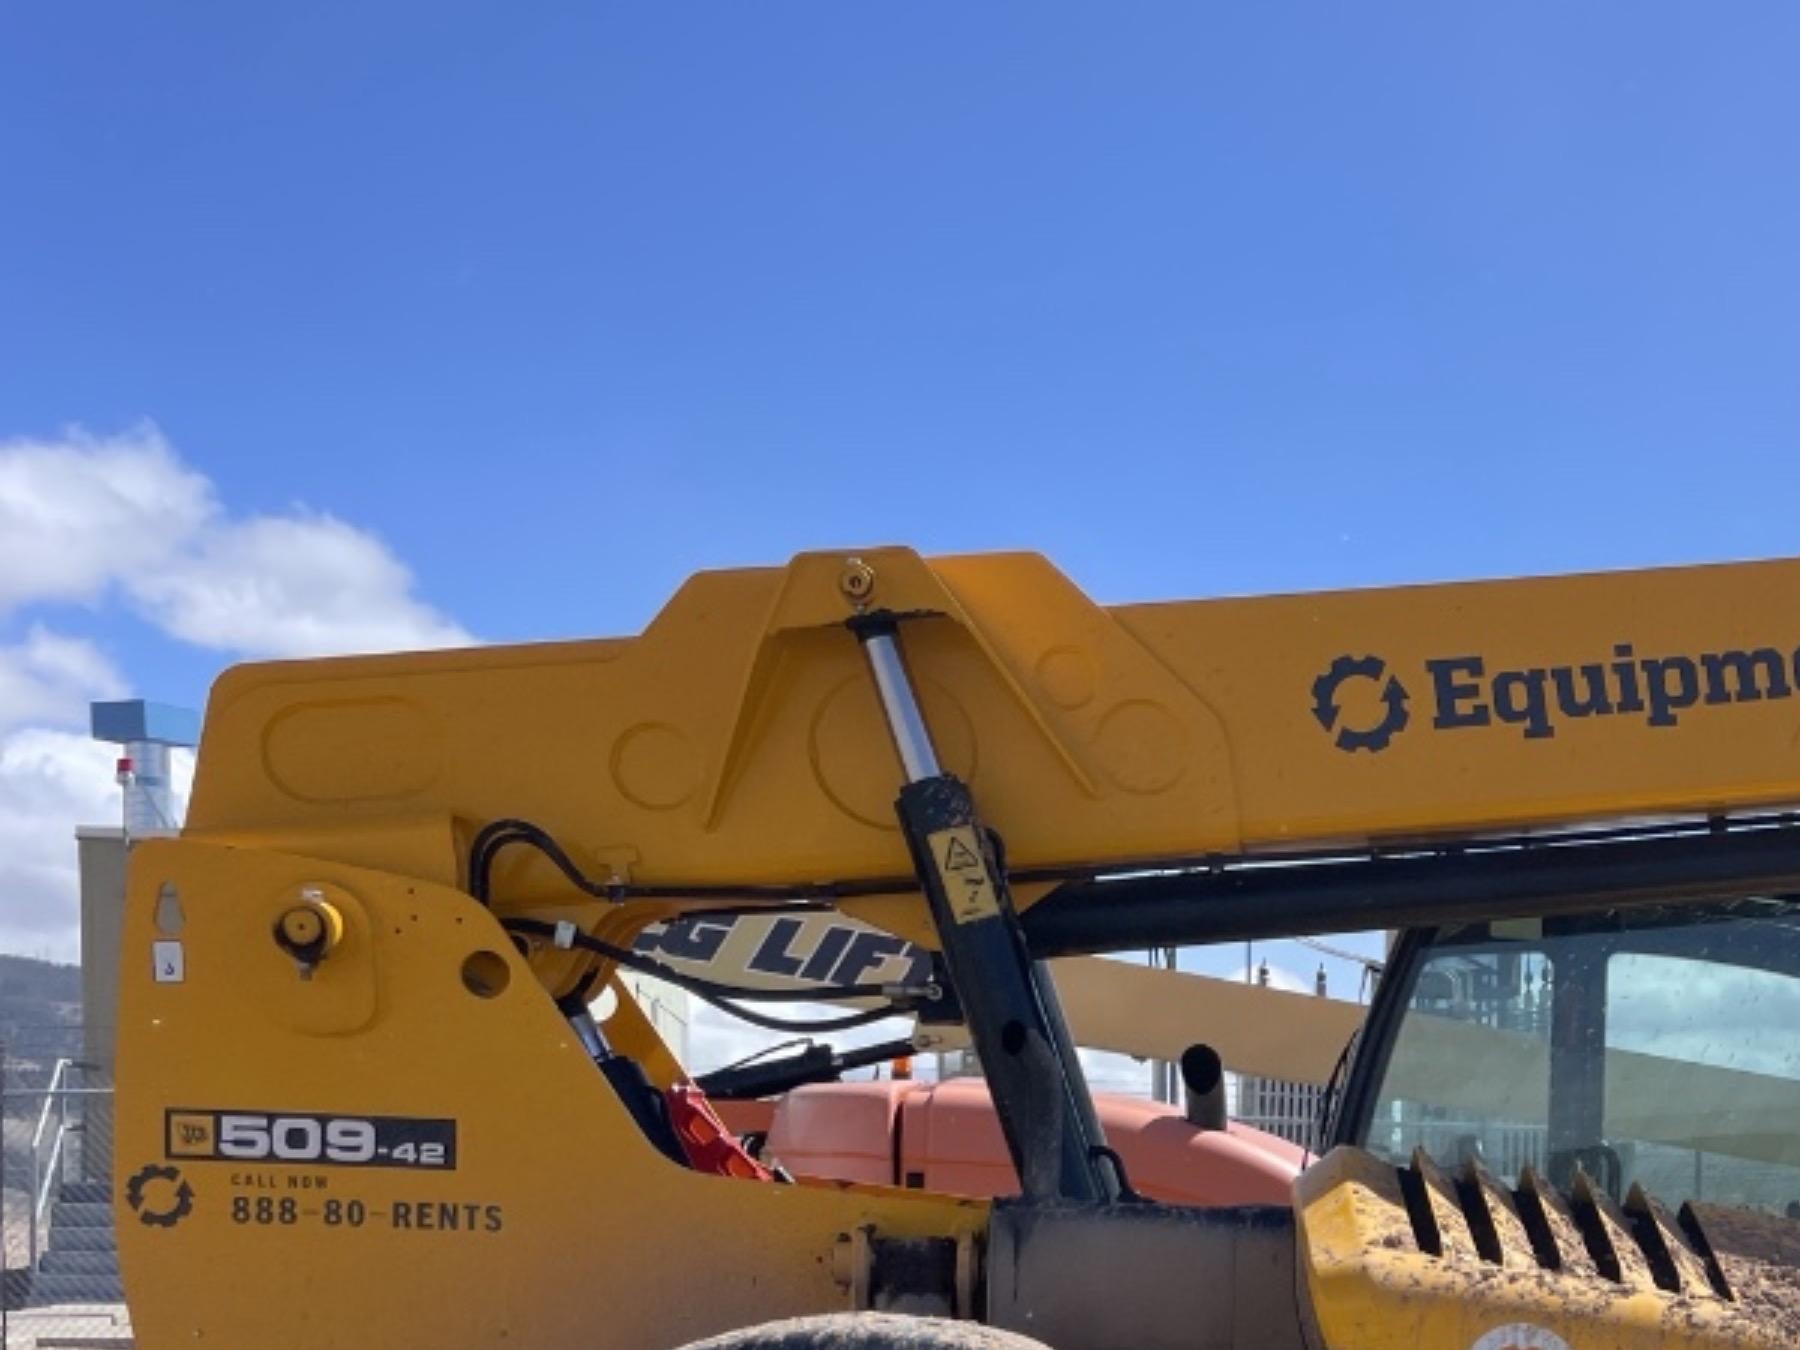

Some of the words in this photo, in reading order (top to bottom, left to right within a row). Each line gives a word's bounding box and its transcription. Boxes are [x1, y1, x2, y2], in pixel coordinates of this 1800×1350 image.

[218, 1113, 446, 1166] 509-42
[230, 1172, 278, 1190] CALL
[286, 1174, 329, 1191] NOW
[231, 1196, 504, 1233] 888-80-RENTS
